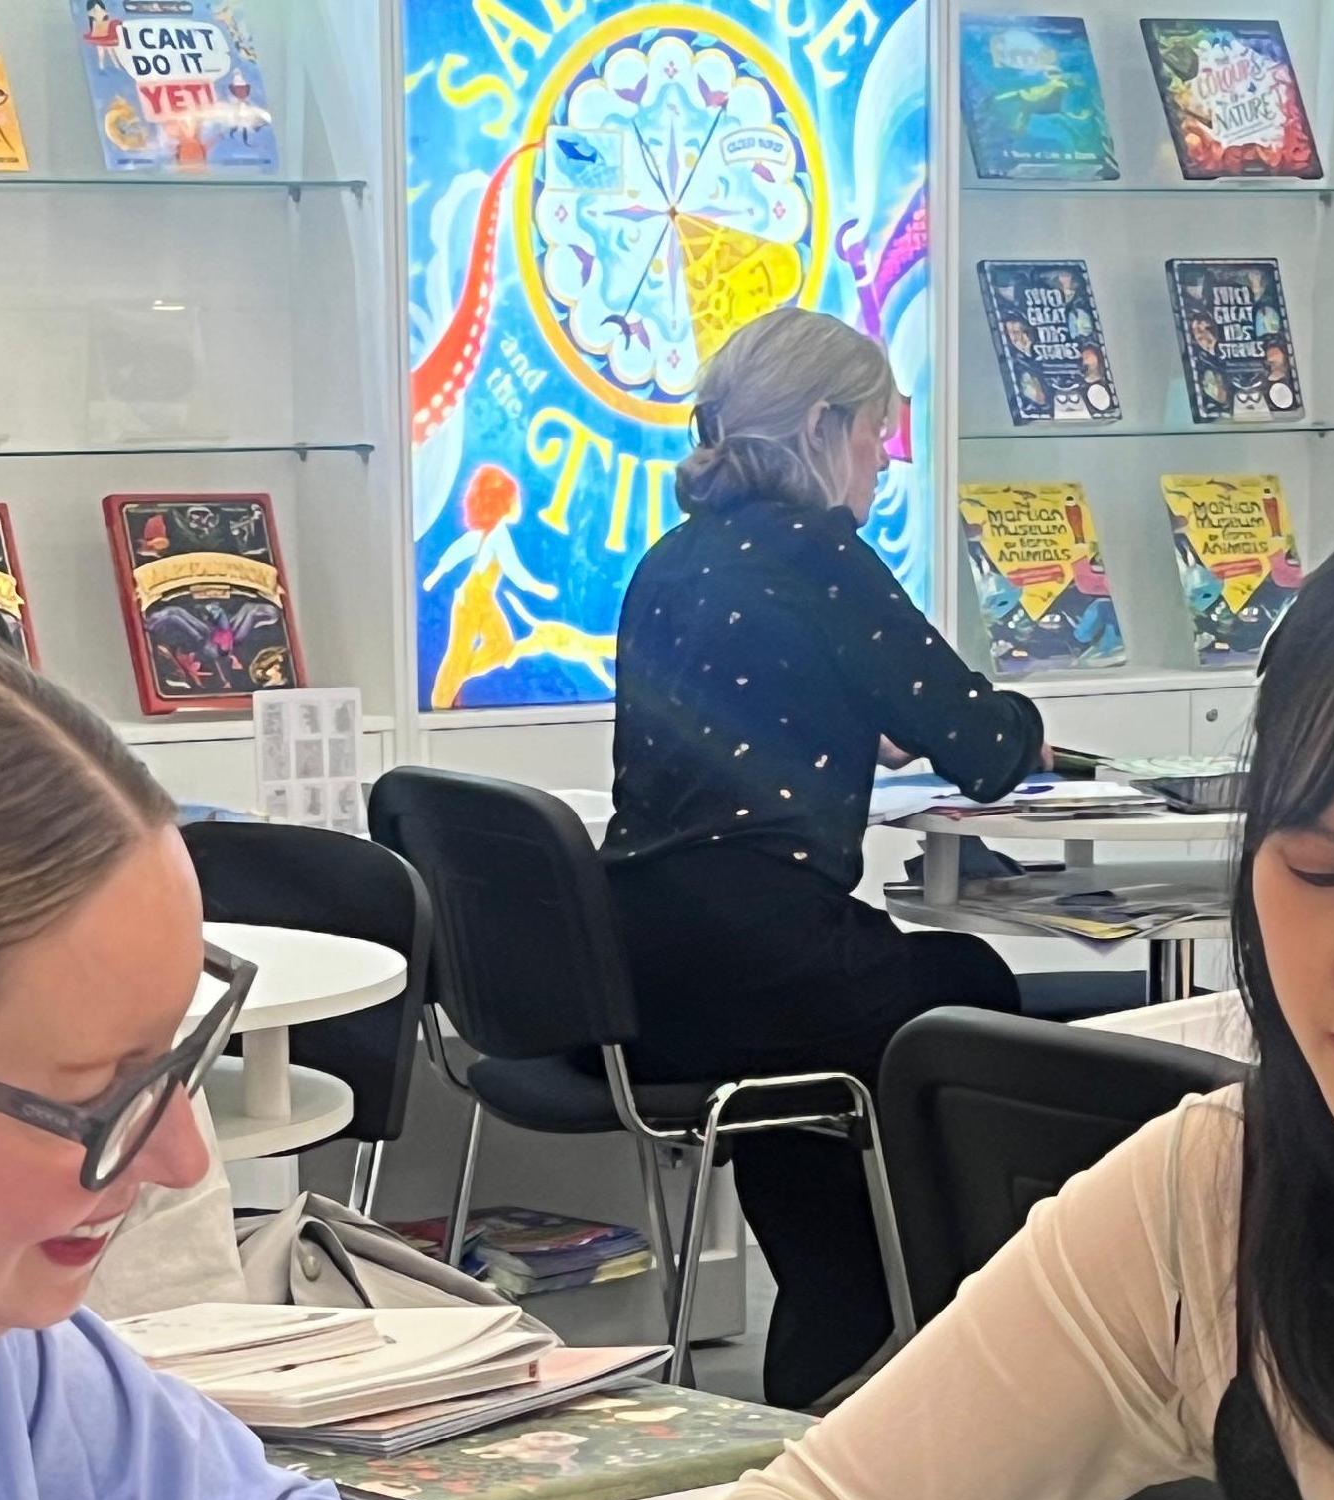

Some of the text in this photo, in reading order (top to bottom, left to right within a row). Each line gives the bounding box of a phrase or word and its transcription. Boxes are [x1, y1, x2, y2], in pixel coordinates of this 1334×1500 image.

[122, 27, 132, 49] I
[132, 54, 171, 76] DO
[1215, 89, 1280, 131] NATURE
[501, 331, 548, 393] and
[486, 367, 523, 419] the
